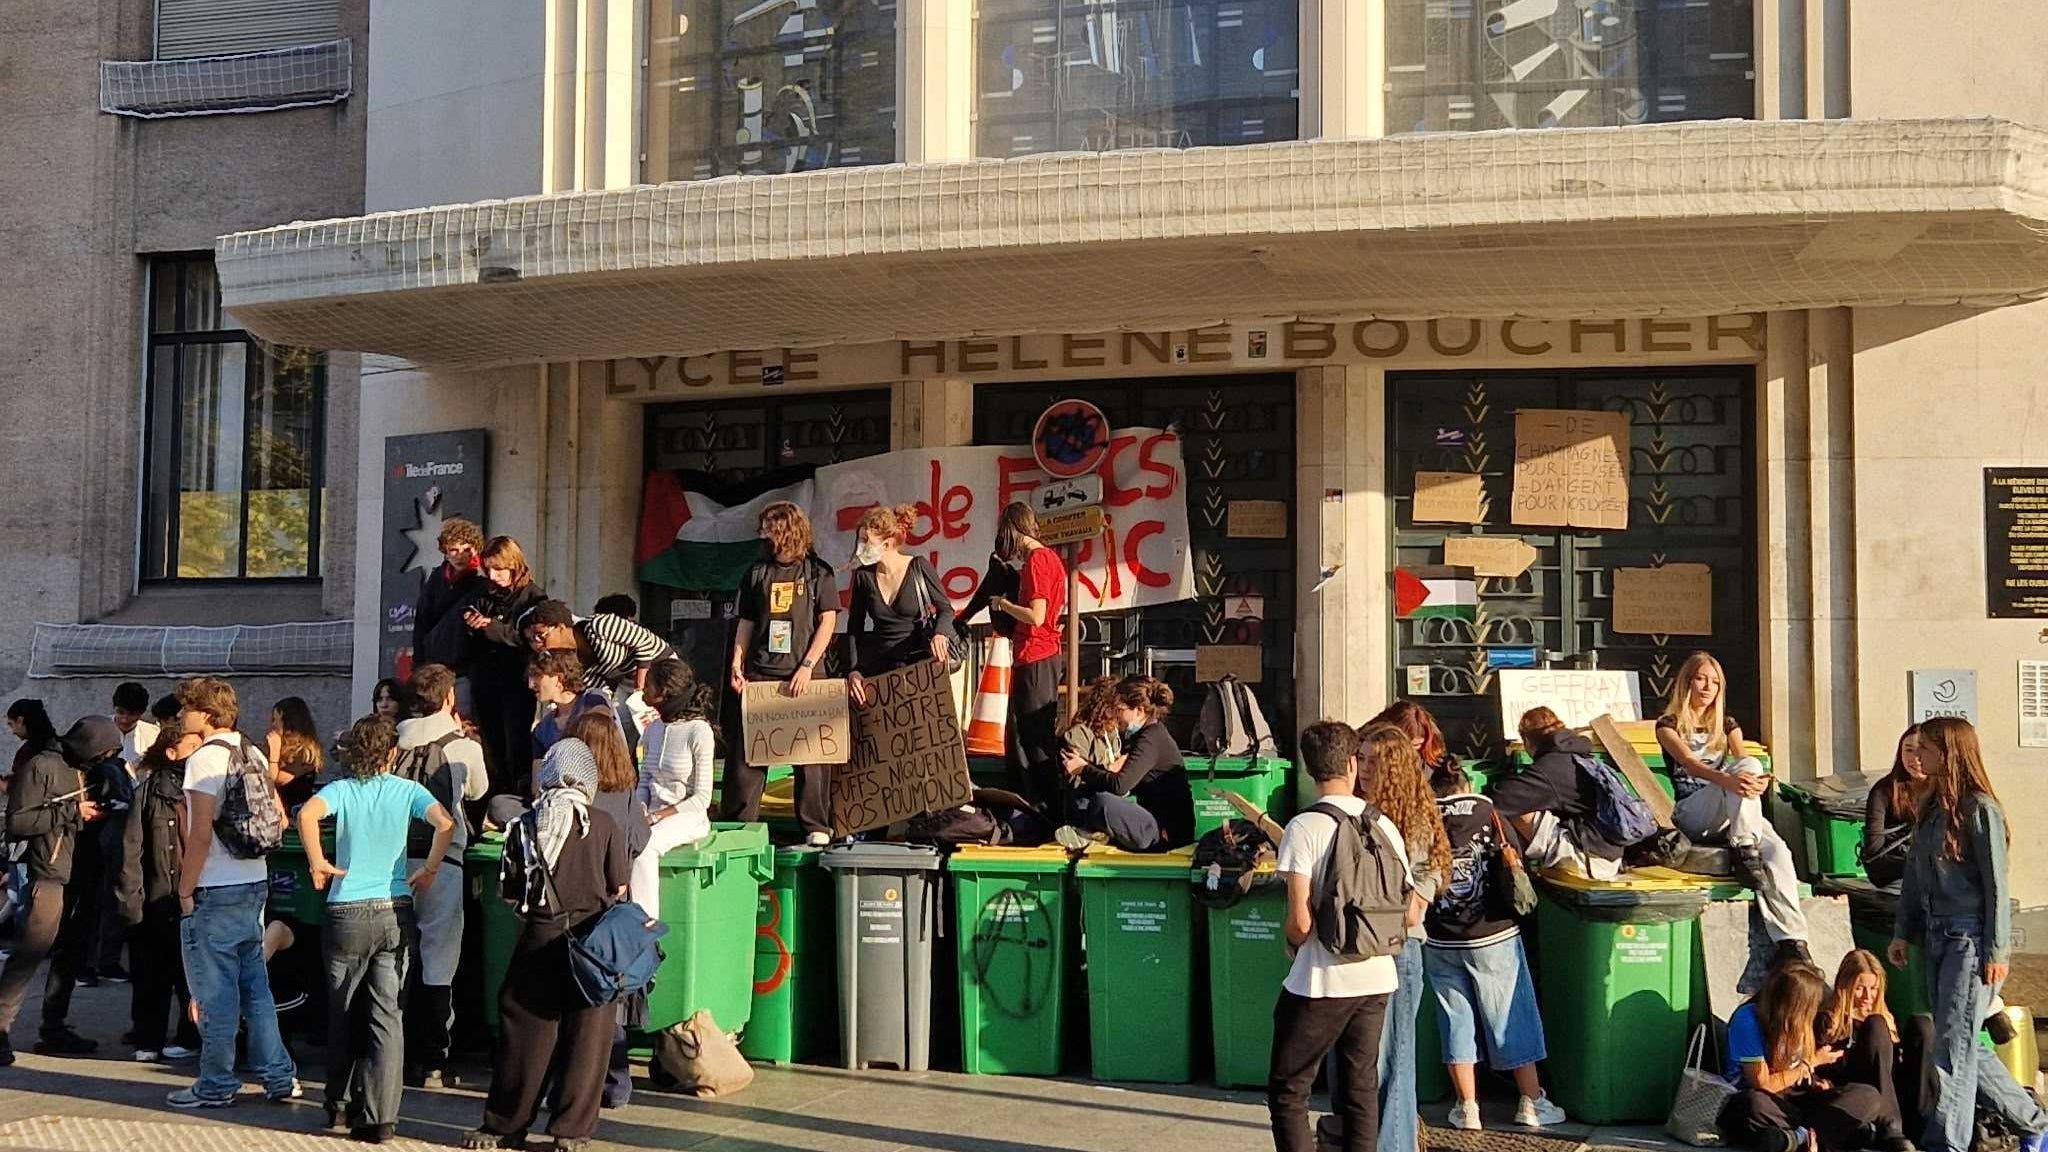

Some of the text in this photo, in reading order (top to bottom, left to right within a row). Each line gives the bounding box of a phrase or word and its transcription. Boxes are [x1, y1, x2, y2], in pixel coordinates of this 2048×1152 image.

[1284, 311, 1767, 358] BOUCHER
[1566, 416, 1597, 434] DE
[1519, 461, 1556, 478] POUR
[1517, 495, 1557, 511] POUR
[1521, 673, 1622, 700] GEFFRAY
[881, 691, 950, 733] NOTRE
[890, 725, 928, 758] QUE
[928, 717, 959, 748] LES
[889, 742, 962, 788] NIQUENT
[834, 770, 967, 836] NOS POUMONS
